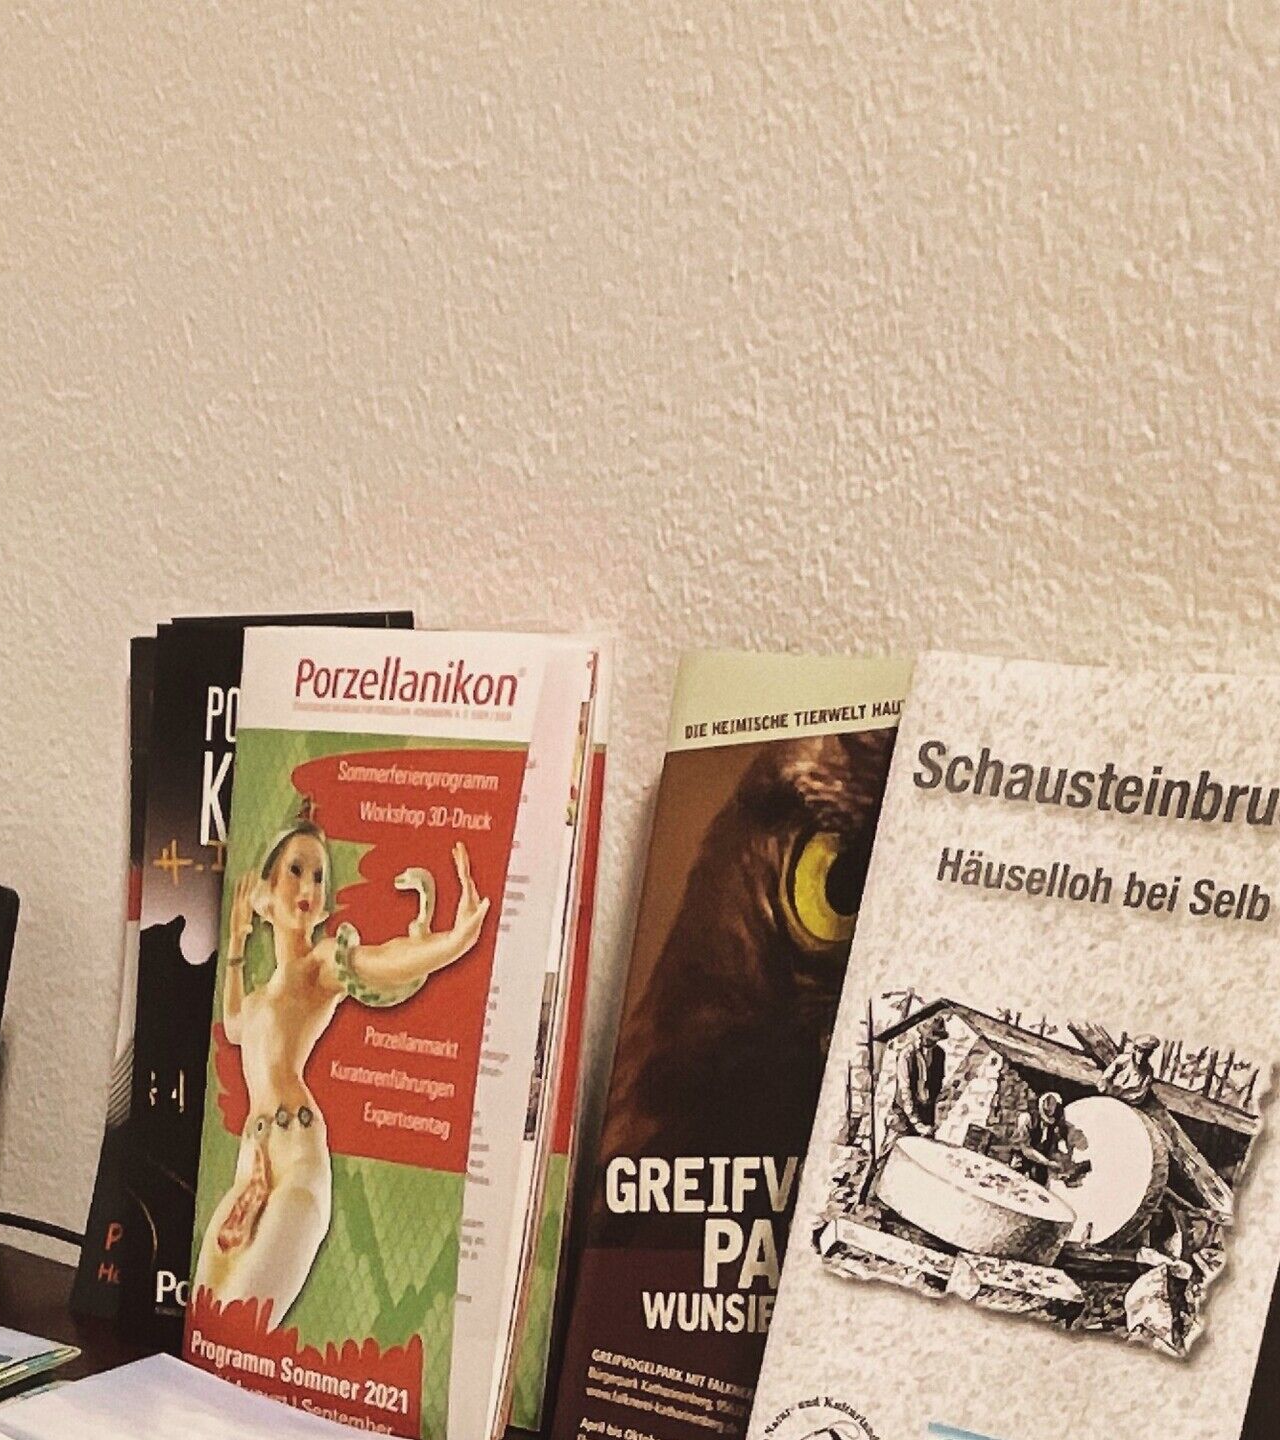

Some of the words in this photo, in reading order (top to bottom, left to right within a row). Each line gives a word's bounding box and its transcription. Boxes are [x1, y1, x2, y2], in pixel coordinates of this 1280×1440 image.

[295, 655, 519, 707] Porzellanikon
[684, 722, 707, 740] DIE
[712, 713, 789, 737] HEIMISCHE
[794, 703, 867, 727] TIERWELT
[872, 699, 907, 718] HAU
[337, 760, 500, 794] Sommerferienprogramm
[359, 800, 425, 829] Workshop
[429, 805, 493, 831] 3D-Druck
[936, 846, 1112, 905] Häuselloh
[1122, 871, 1180, 914] bei
[1189, 877, 1272, 923] Selb
[364, 1025, 459, 1060] Porzellanmarkt
[330, 1060, 456, 1101] Kuratorenführungen
[364, 1101, 452, 1142] Expertisentag
[605, 1155, 801, 1214] GREIFV
[190, 1329, 276, 1378] Programm
[280, 1356, 361, 1401] Sommer
[364, 1379, 409, 1415] 2021
